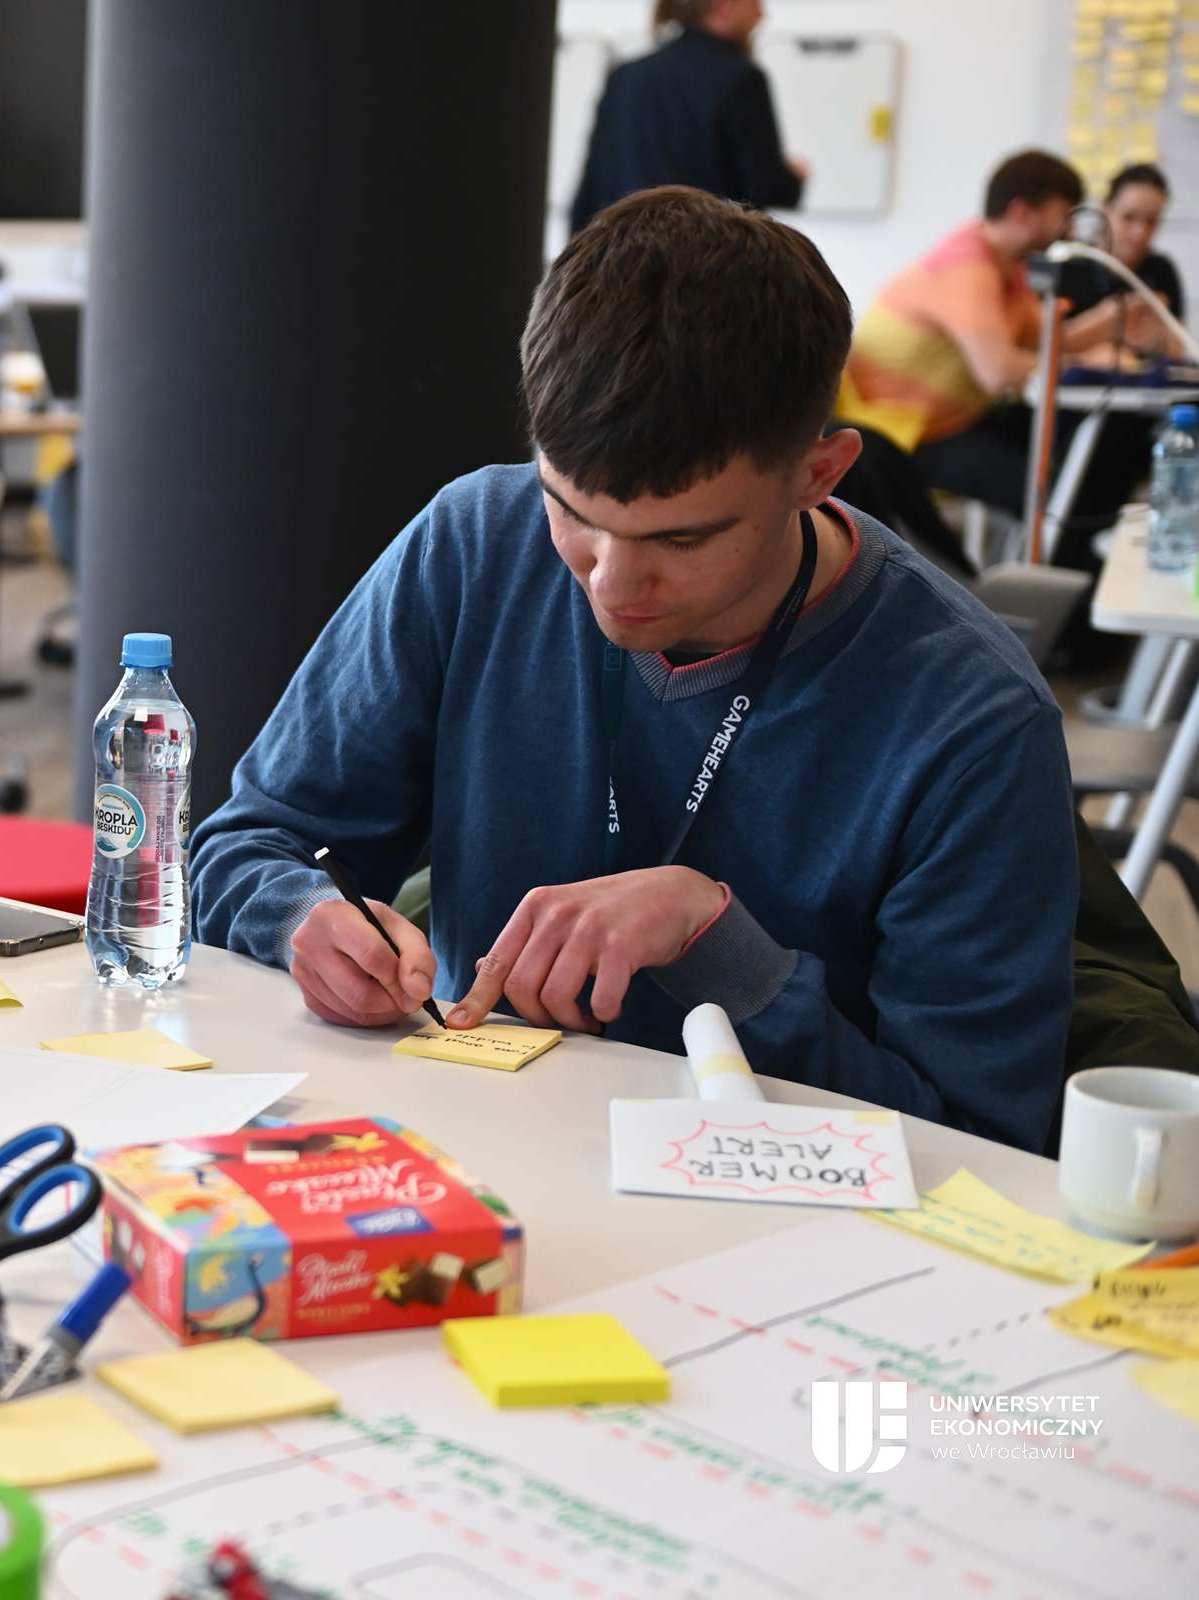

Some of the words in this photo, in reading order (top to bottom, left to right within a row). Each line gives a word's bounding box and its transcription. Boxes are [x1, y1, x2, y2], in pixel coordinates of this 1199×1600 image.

[686, 694, 750, 813] GAMEHEARTS
[608, 776, 620, 834] ARTS
[97, 820, 132, 836] BESKIDU
[708, 1135, 832, 1160] ALERT
[689, 1160, 867, 1187] BOOMER
